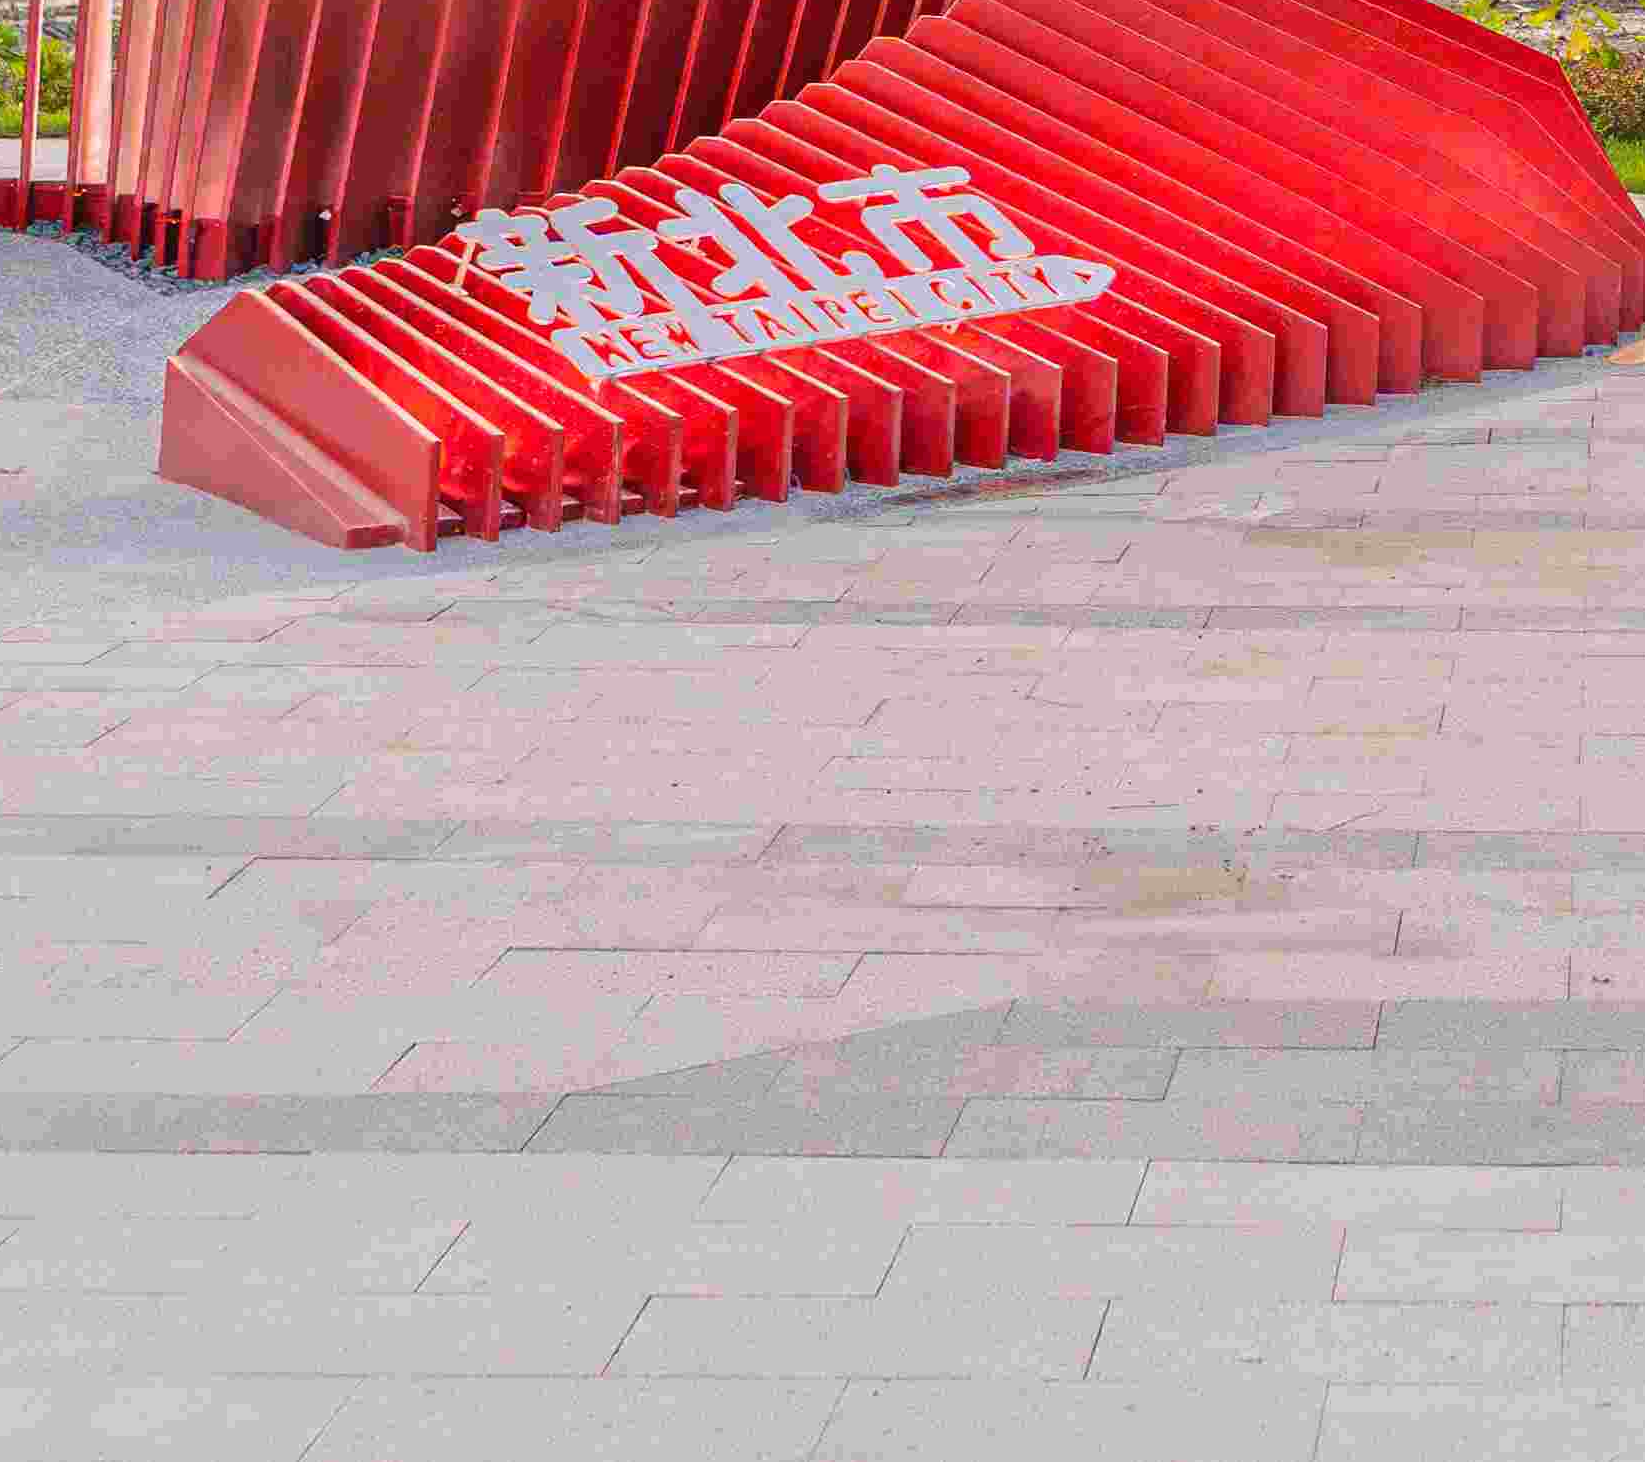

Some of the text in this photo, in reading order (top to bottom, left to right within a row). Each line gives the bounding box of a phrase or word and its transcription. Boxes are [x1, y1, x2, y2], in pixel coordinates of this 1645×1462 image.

[455, 163, 1036, 325] 新北市
[580, 265, 1061, 368] NEW TAIPEI CITY
